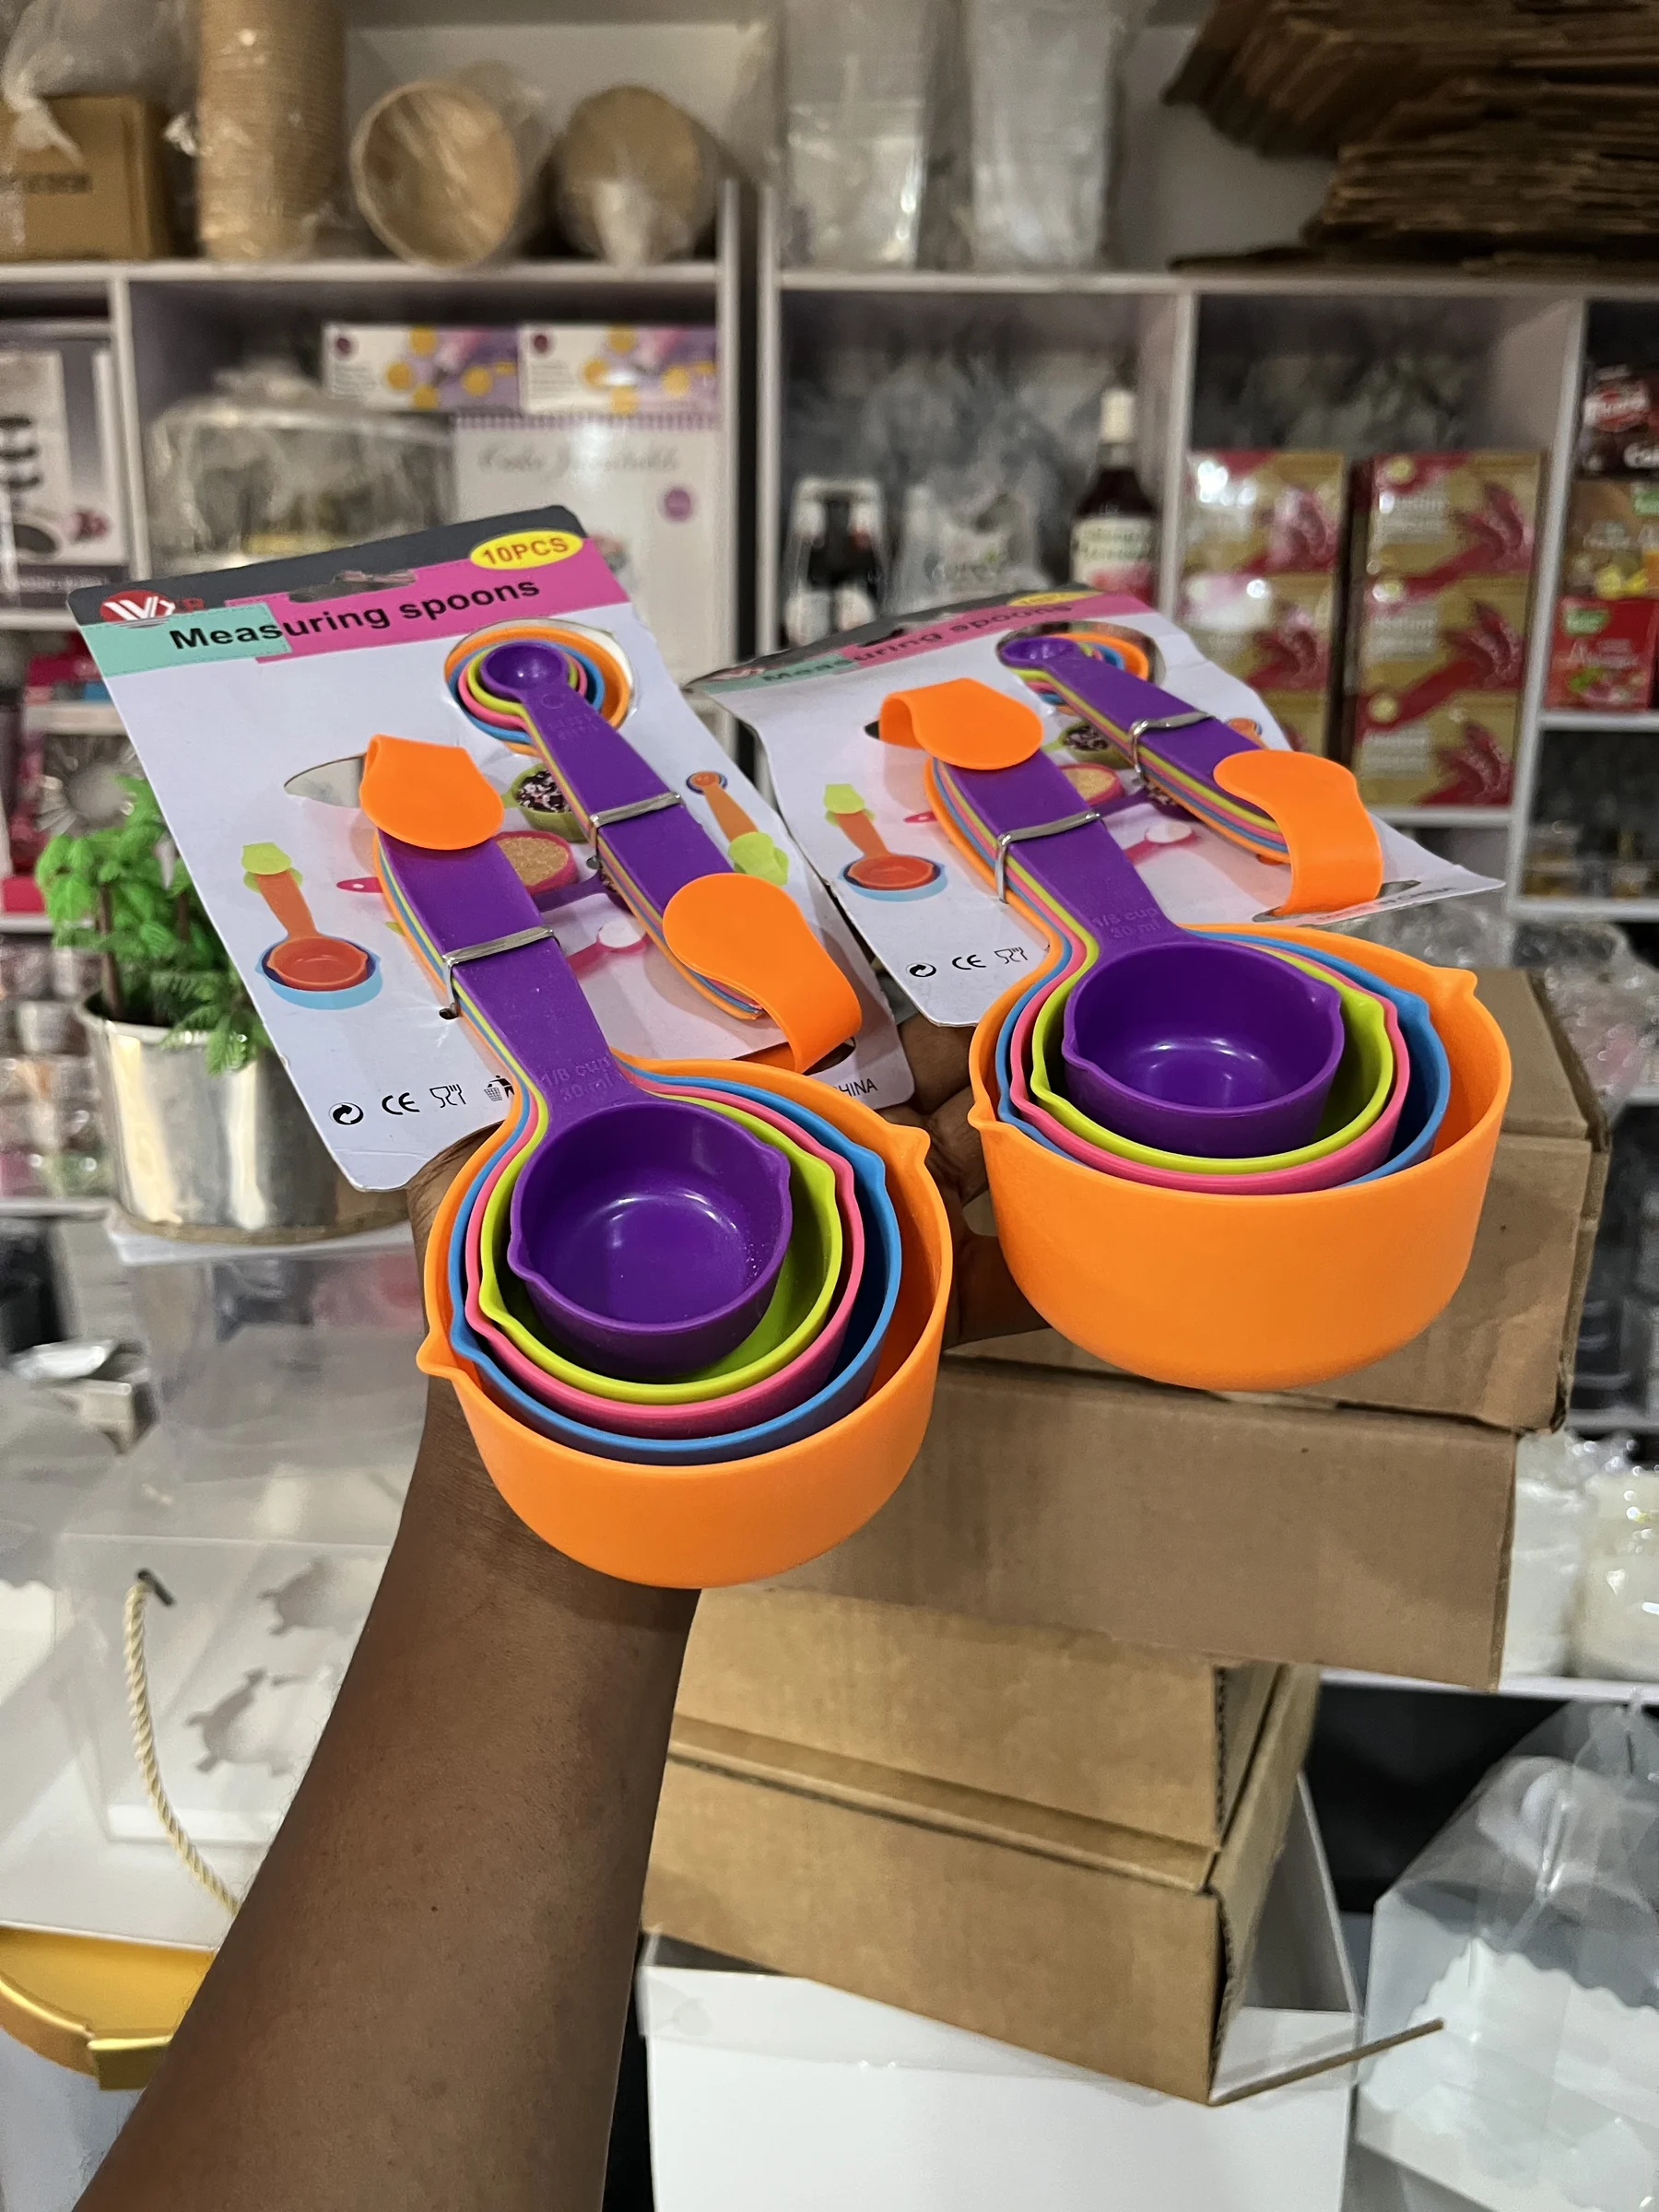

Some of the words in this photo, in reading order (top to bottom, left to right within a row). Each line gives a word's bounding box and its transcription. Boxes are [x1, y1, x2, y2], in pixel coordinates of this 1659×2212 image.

[481, 536, 571, 566] 10PCS
[169, 607, 390, 650] Measuring
[400, 578, 540, 621] spoons
[949, 604, 1072, 633] spoons
[833, 1077, 878, 1097] HINA
